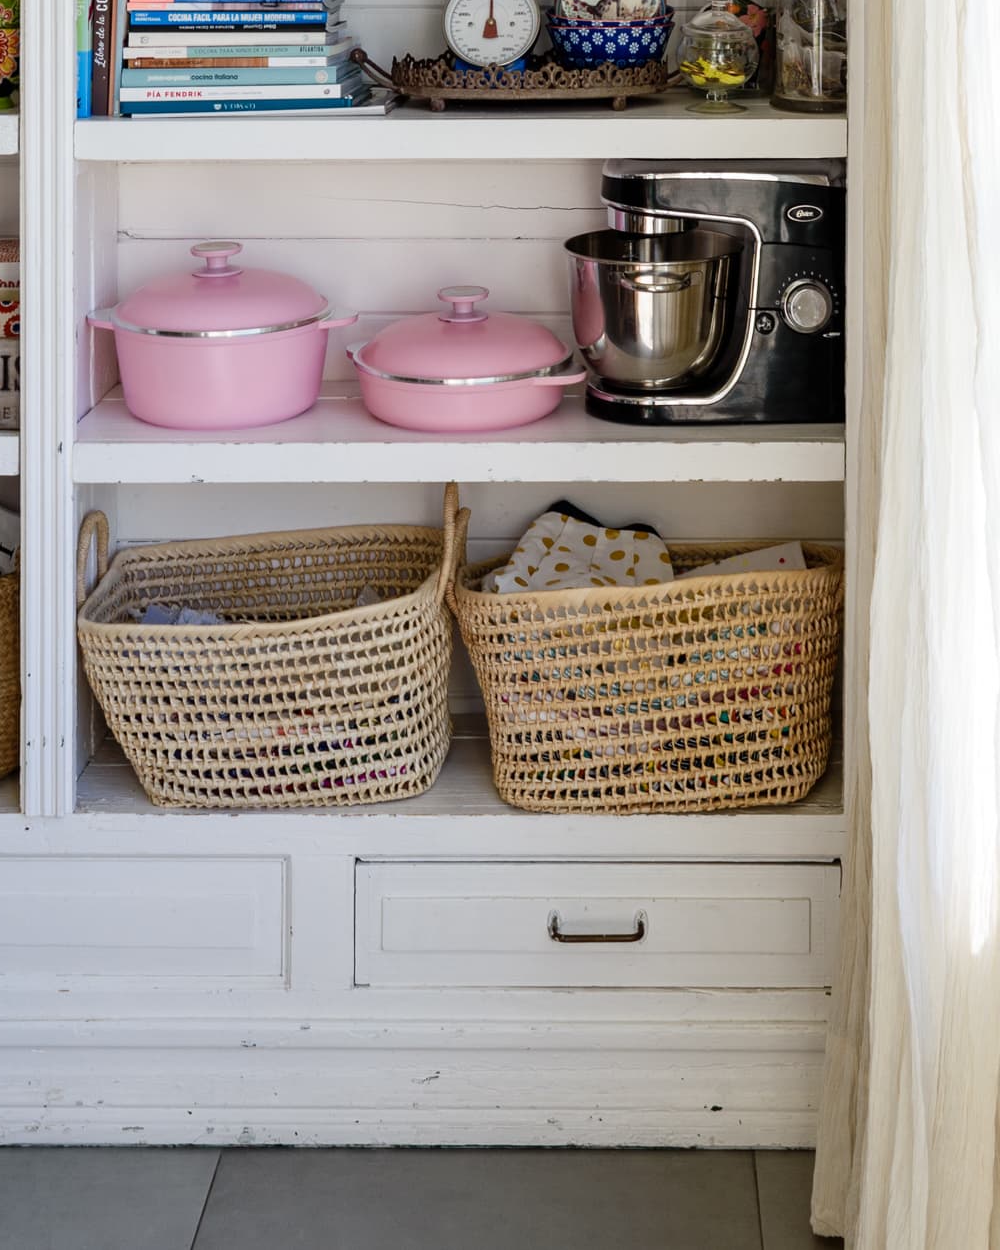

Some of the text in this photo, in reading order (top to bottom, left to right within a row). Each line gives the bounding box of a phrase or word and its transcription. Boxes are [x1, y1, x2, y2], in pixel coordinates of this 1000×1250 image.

[97, 15, 106, 24] la
[168, 13, 192, 22] COCINA
[193, 13, 211, 22] FACIL
[212, 13, 230, 22] PARA
[231, 13, 240, 22] LA
[240, 13, 262, 22] MUJER
[264, 13, 296, 22] MODERNA
[95, 25, 106, 38] de
[94, 38, 107, 68] Libro
[164, 90, 203, 98] FENDRIK
